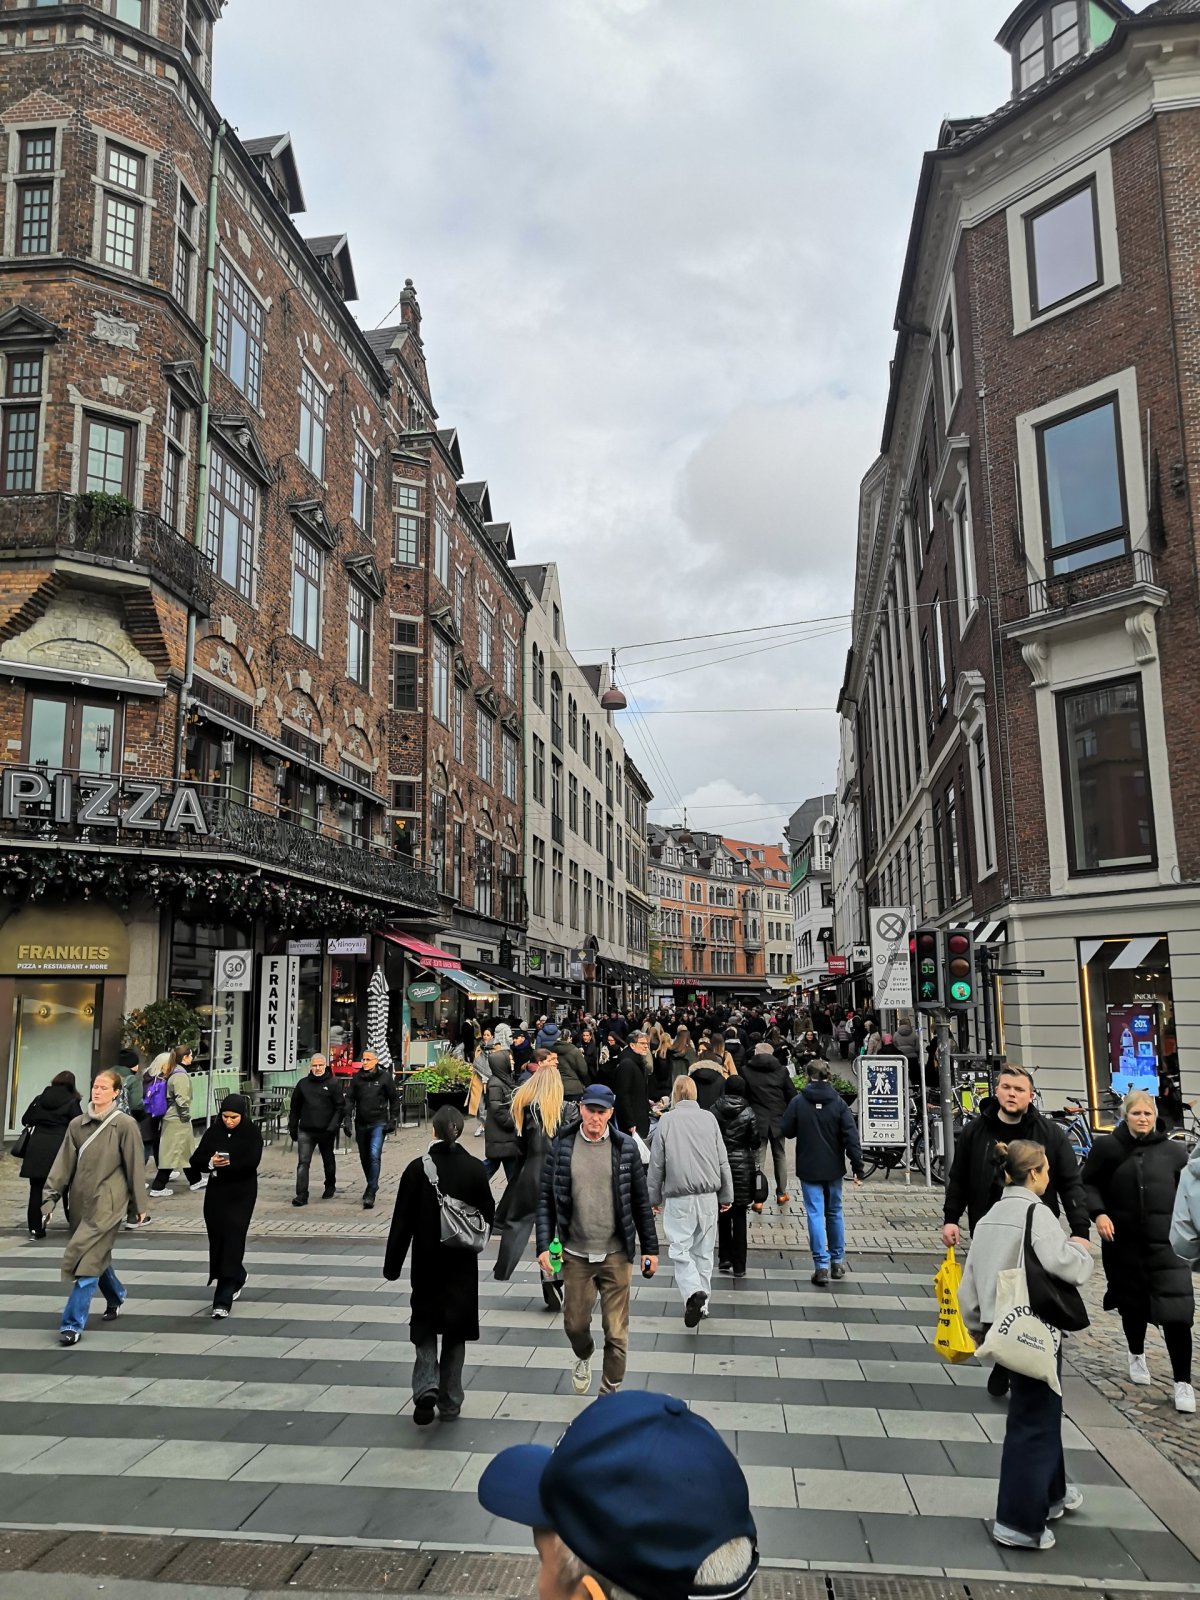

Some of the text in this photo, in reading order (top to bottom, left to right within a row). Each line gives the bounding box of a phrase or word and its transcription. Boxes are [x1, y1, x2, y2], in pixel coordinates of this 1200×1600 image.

[2, 768, 208, 835] PIZZA
[18, 945, 110, 960] FRANKIES
[227, 962, 242, 973] 30
[267, 961, 279, 1065] FRANKIES
[288, 961, 296, 1064] FRANKIES
[1134, 1020, 1148, 1028] 20%
[998, 1312, 1016, 1335] SYD
